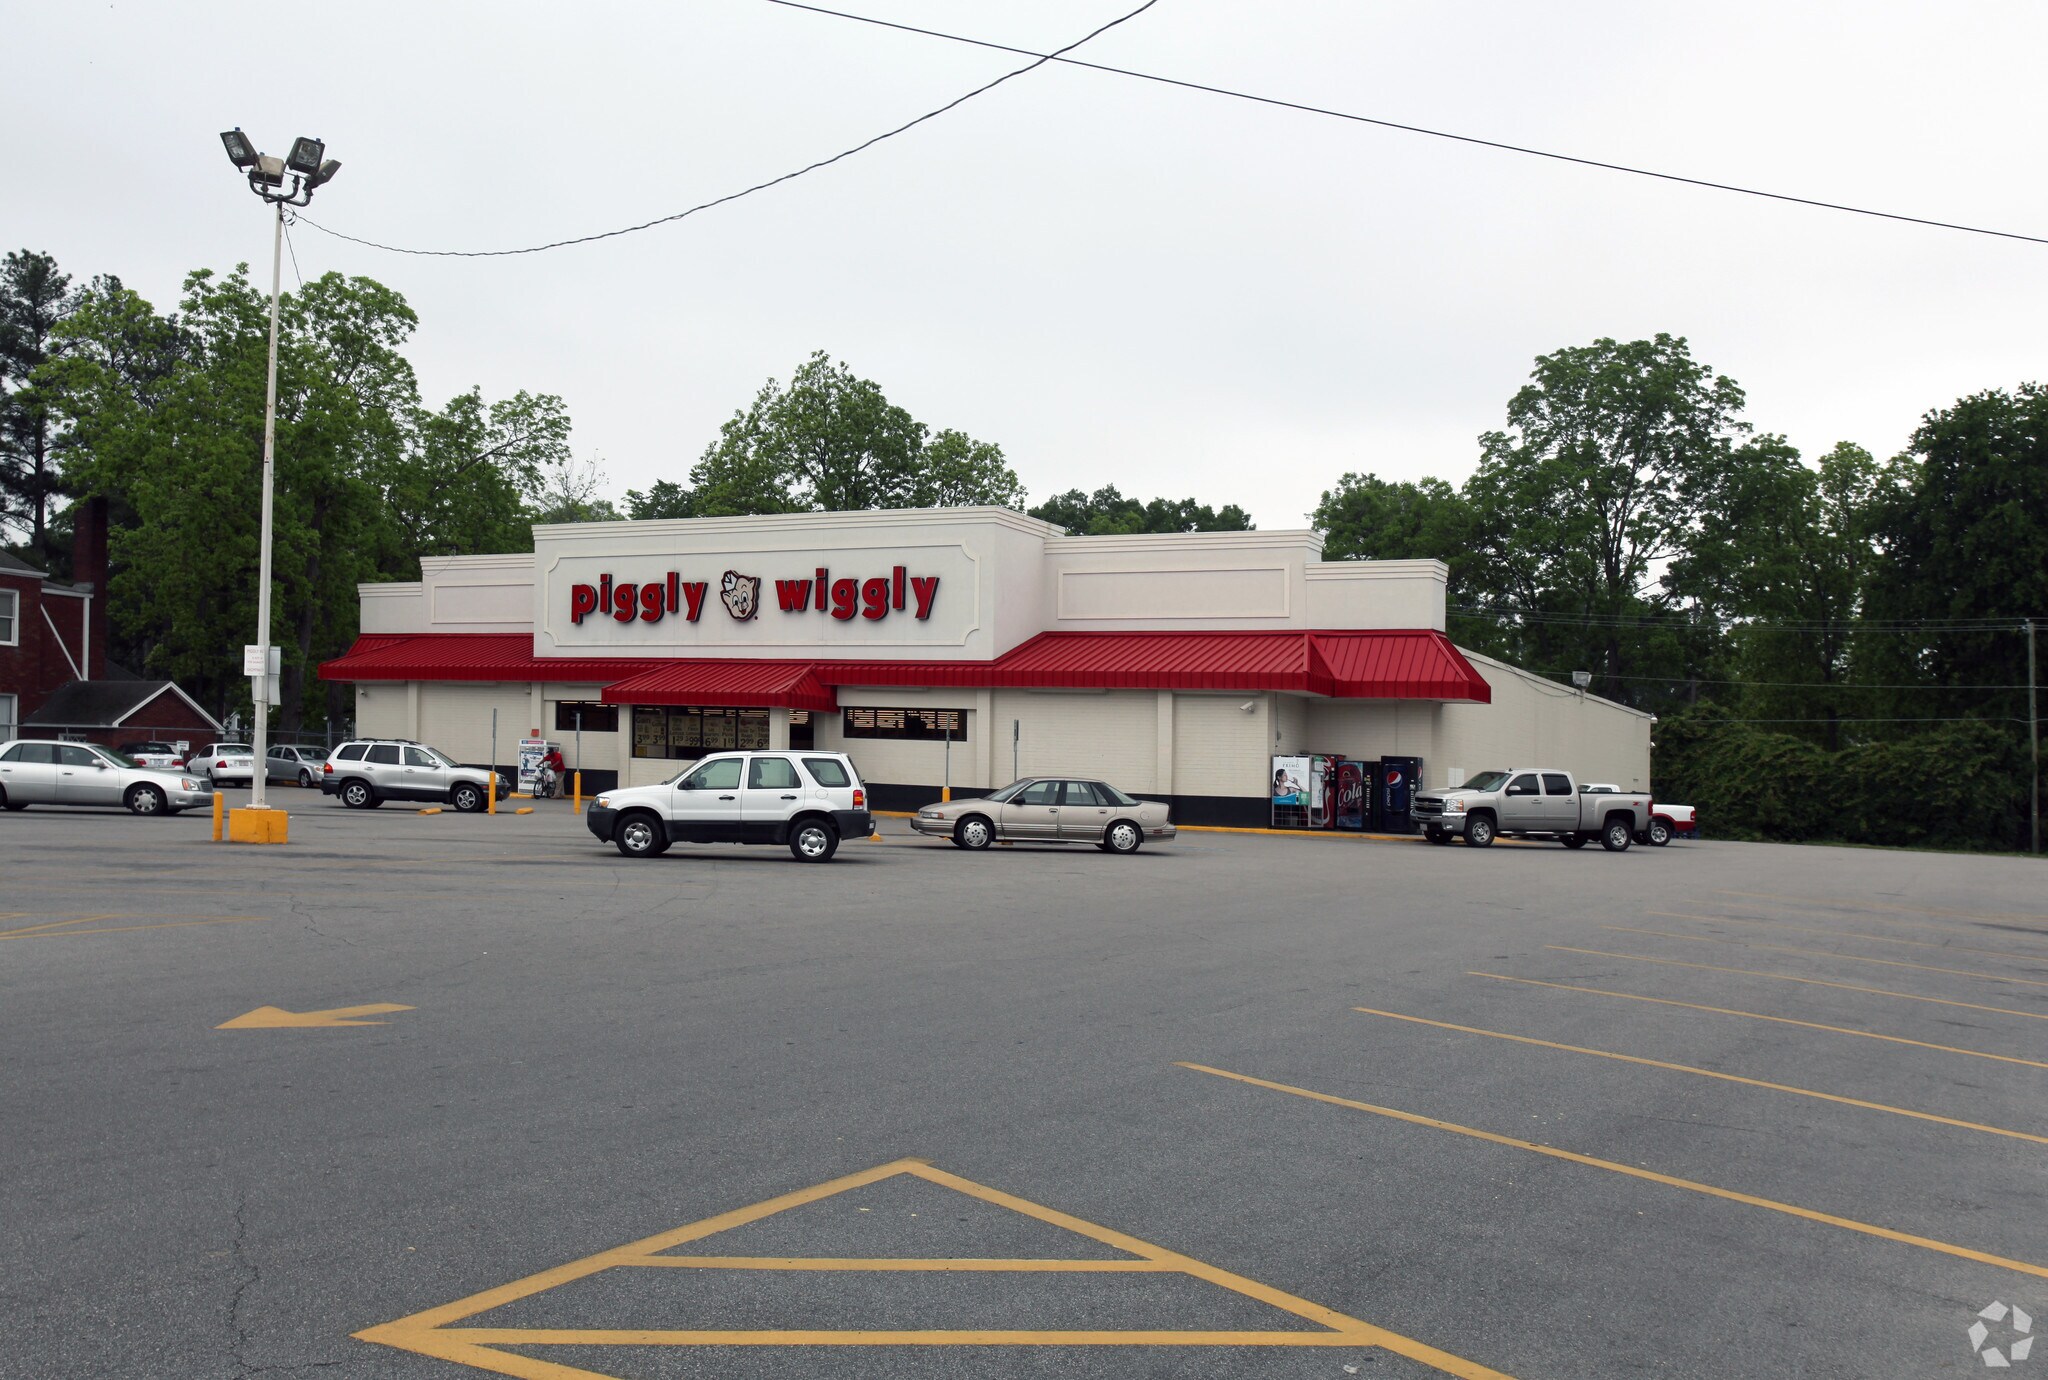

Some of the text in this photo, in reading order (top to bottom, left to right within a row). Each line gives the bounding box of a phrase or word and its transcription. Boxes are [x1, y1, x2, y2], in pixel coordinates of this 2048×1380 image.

[571, 565, 941, 624] piggly wiggly
[1337, 782, 1363, 807] Cola
